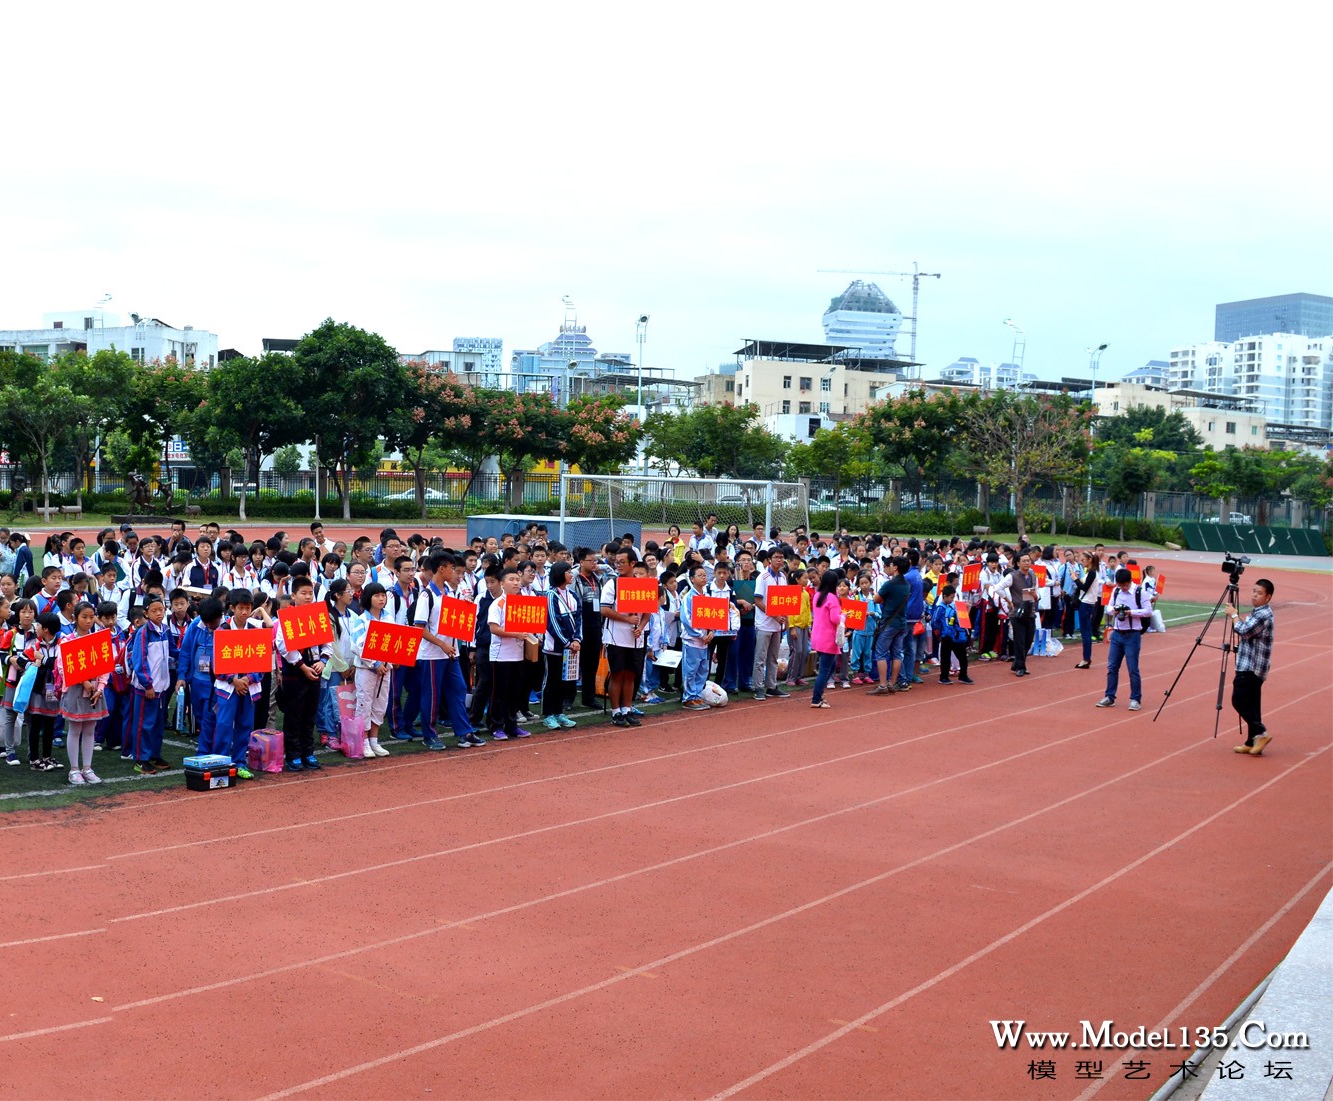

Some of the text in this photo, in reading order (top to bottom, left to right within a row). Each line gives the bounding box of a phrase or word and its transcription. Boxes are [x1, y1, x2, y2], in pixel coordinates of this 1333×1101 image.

[441, 607, 474, 632] 双十中学
[696, 607, 725, 620] 乐海小学
[221, 643, 266, 659] 金尚小学
[367, 630, 417, 656] 东渡小学
[66, 640, 110, 673] 乐安小学
